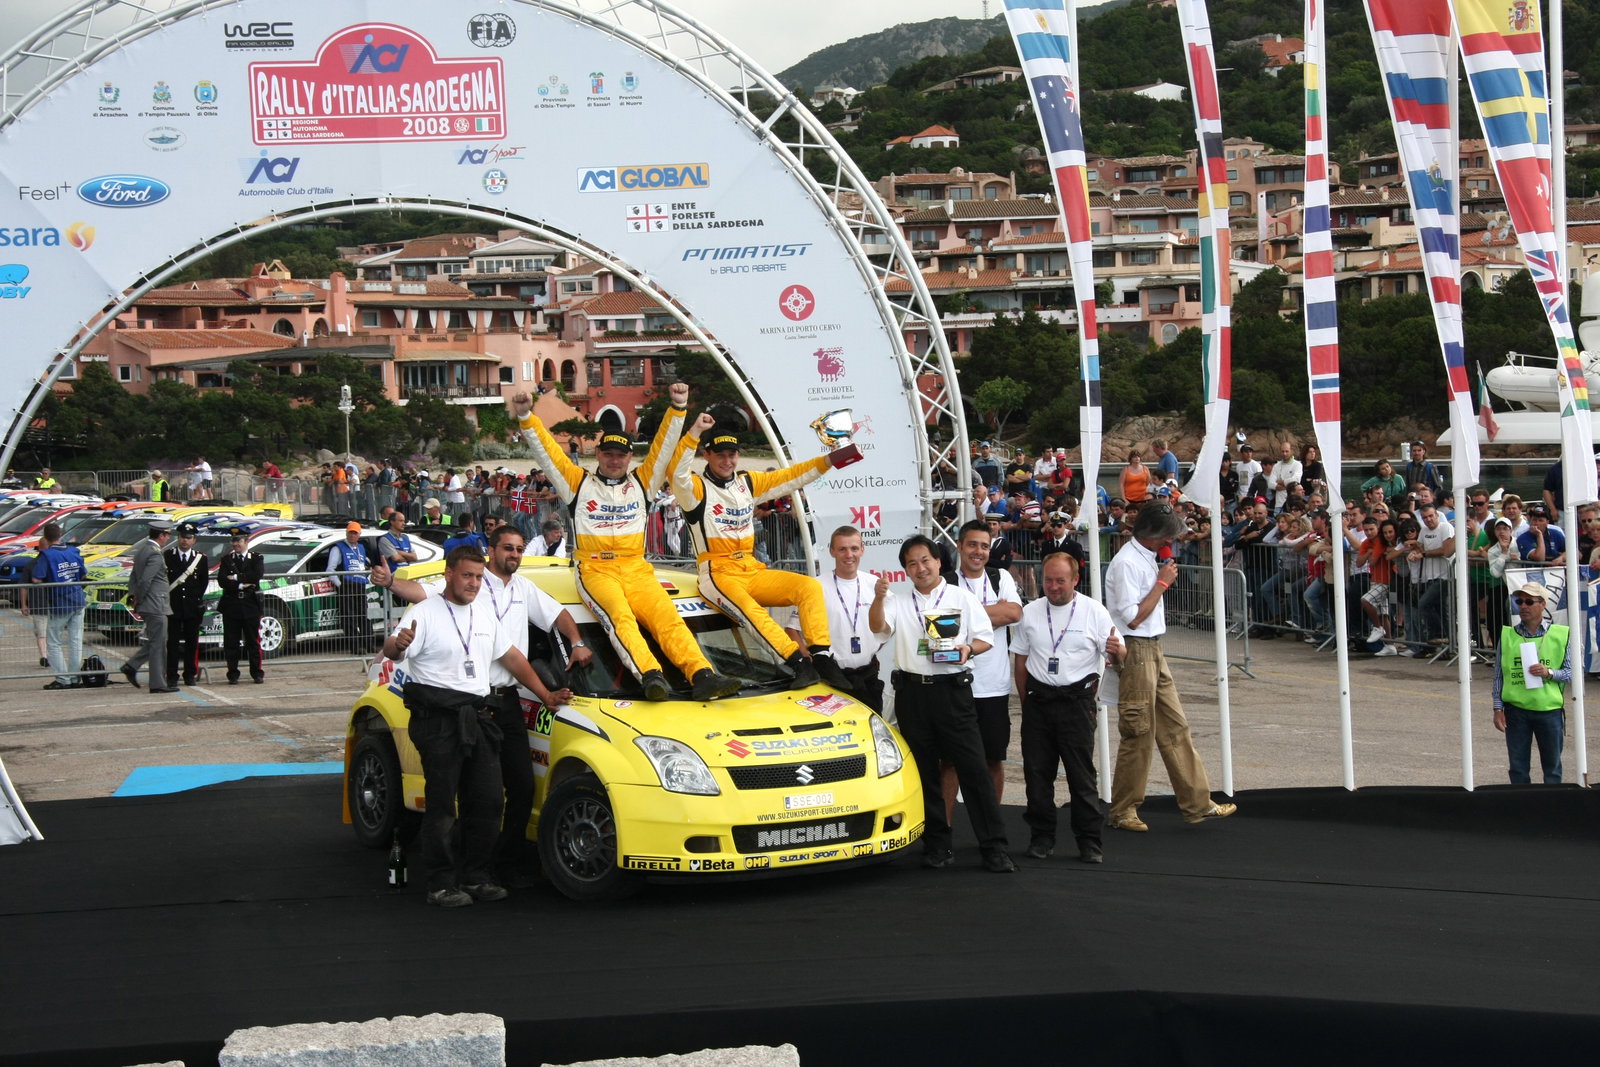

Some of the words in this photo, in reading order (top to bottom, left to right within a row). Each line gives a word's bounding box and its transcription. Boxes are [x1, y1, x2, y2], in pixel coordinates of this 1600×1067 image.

[257, 70, 317, 116] RALLY
[402, 117, 450, 135] 2008
[620, 166, 708, 189] GLOBAL
[95, 178, 152, 203] Ford
[238, 187, 285, 197] Automobile
[286, 187, 306, 196] Club
[307, 186, 334, 195] d'Italia
[671, 202, 697, 211] ENTE
[672, 211, 716, 220] FORESTE
[672, 221, 704, 230] DELLA
[707, 219, 765, 229] SARDEGNA
[719, 265, 750, 274] BRUNO
[760, 326, 786, 335] MARINA
[795, 324, 818, 333] PORTO
[819, 323, 842, 331] CERVO
[807, 387, 830, 395] CERVO
[831, 385, 855, 393] HOTEL
[828, 475, 907, 490] wokita.com
[600, 501, 640, 513] SUZUKI
[861, 529, 881, 538] rnak
[536, 706, 553, 735] 35
[751, 738, 809, 751] SUZUKI
[811, 732, 853, 746] SPORT
[783, 746, 836, 756] EUROPE
[793, 794, 833, 807] SSE-002
[757, 804, 859, 822] WWW.SUZUKISPORT-EUROPE.COM
[757, 822, 850, 848] MICHAL
[888, 836, 907, 849] Beta
[623, 855, 681, 870] PIRELLI
[746, 857, 770, 868] OMP
[779, 852, 810, 863] SUZUKI
[813, 850, 839, 859] SPORT
[702, 859, 735, 870] Beta
